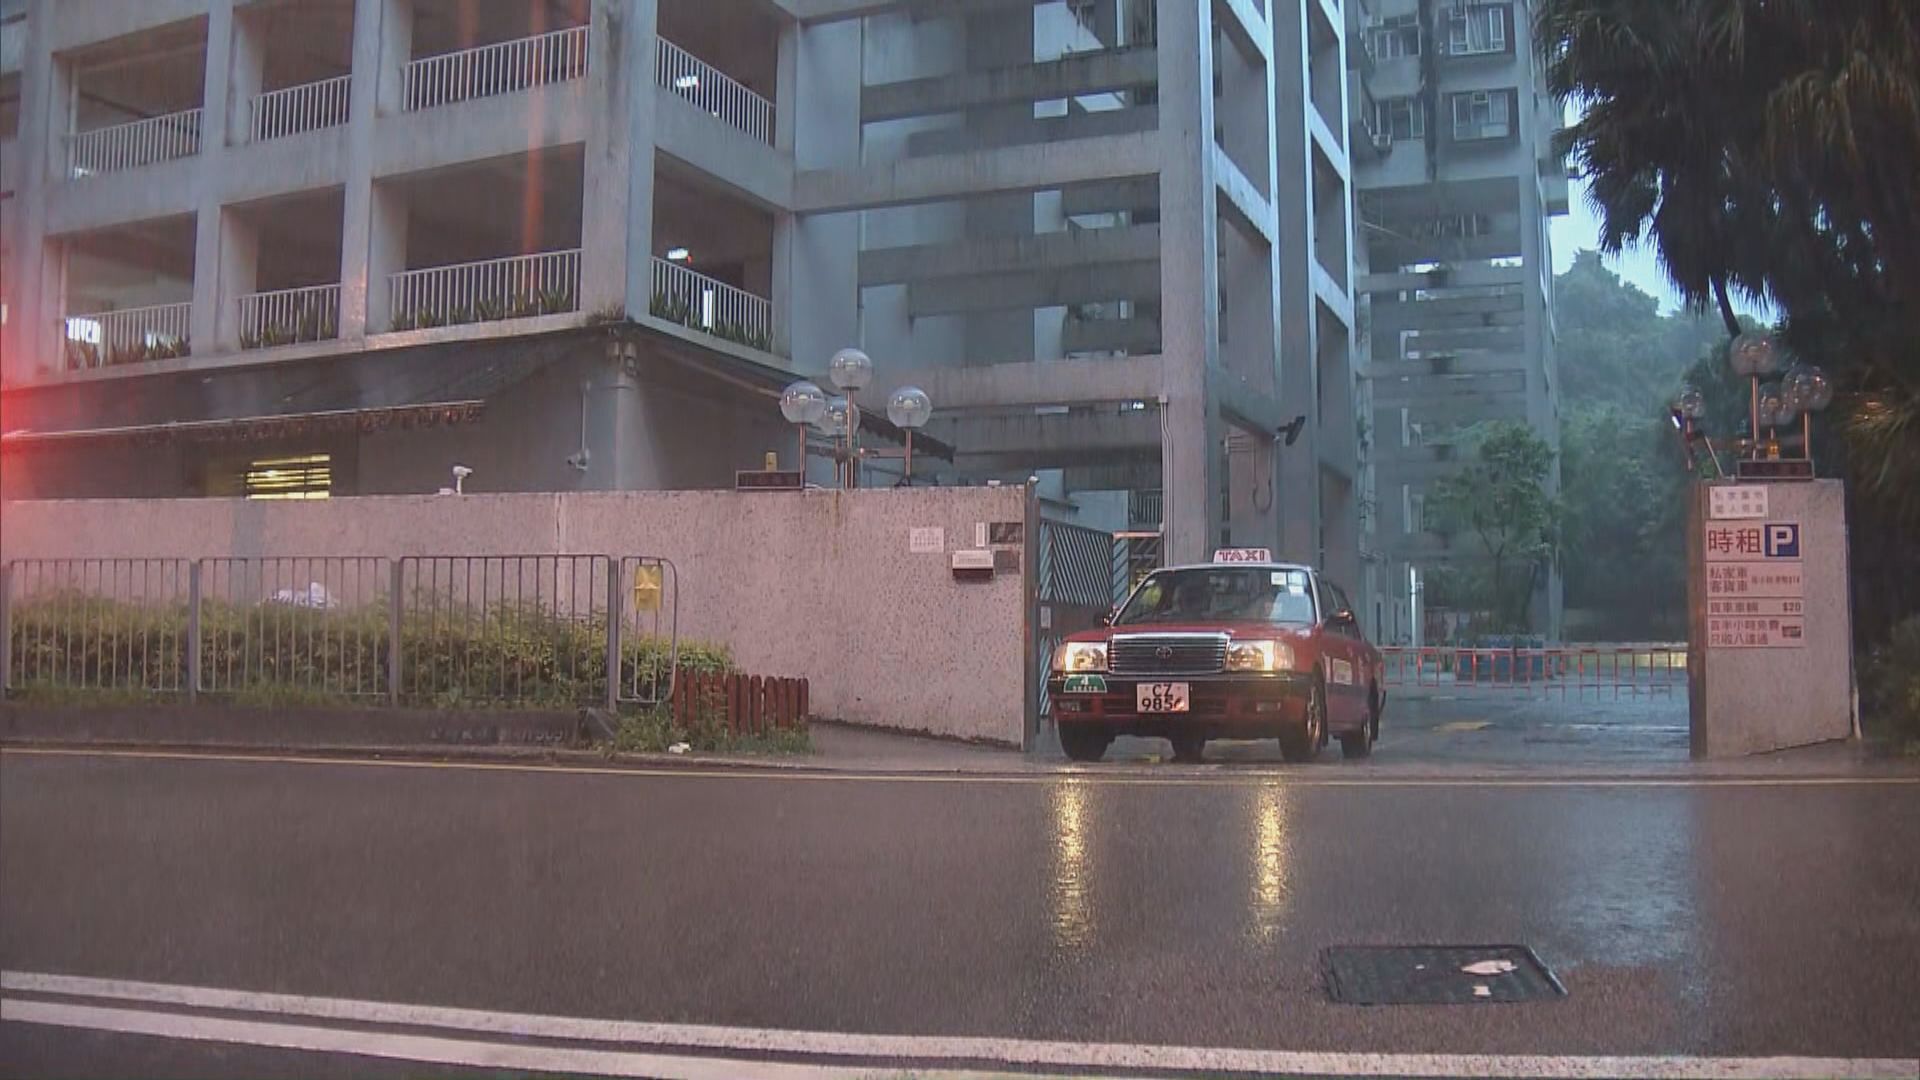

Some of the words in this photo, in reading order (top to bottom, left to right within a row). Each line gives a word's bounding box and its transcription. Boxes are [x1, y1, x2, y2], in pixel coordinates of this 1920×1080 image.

[1708, 527, 1761, 553] 時租
[1219, 550, 1265, 561] TAXI
[1783, 602, 1801, 612] $20
[1152, 684, 1173, 697] CZ
